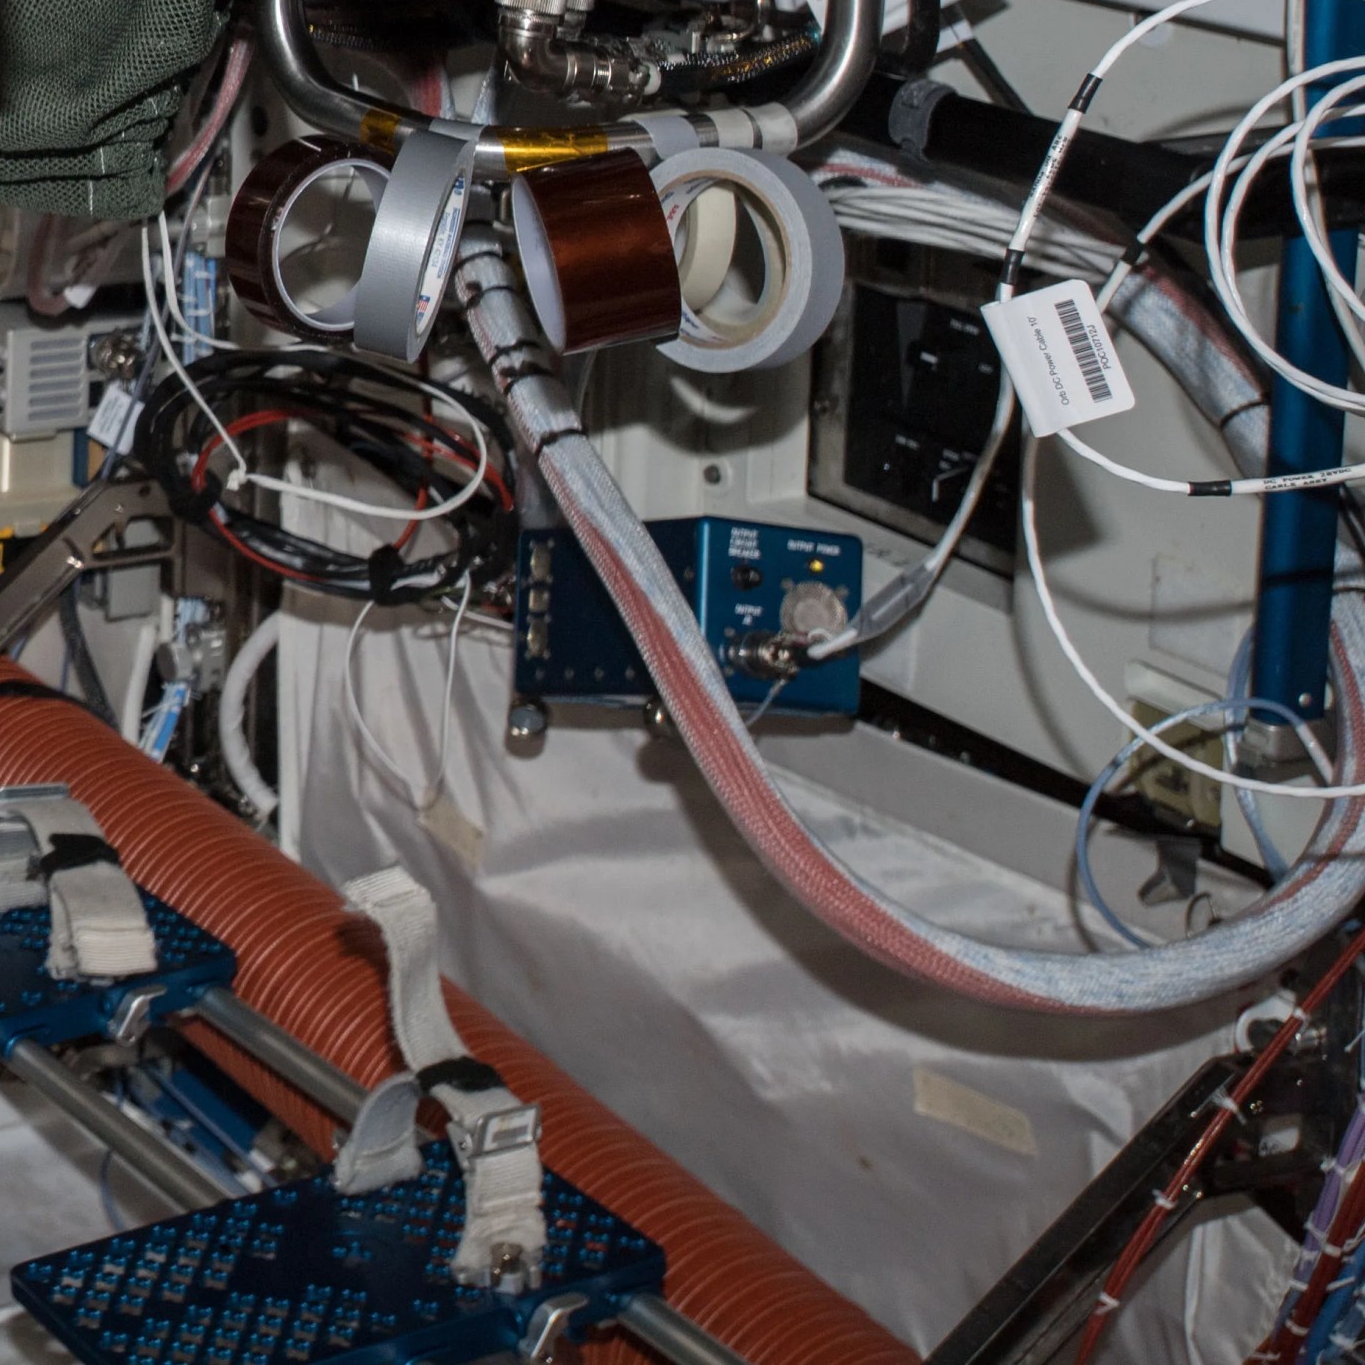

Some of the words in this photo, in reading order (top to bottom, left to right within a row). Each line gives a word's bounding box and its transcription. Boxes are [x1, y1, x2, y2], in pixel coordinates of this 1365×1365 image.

[1033, 328, 1048, 351] Cable
[1043, 352, 1057, 377] Power
[1052, 377, 1064, 390] DC
[1059, 390, 1070, 406] Orb
[1265, 482, 1297, 490] CABLE
[1282, 474, 1315, 483] POWER
[787, 539, 815, 552] OUTPUT
[816, 543, 841, 556] POWER
